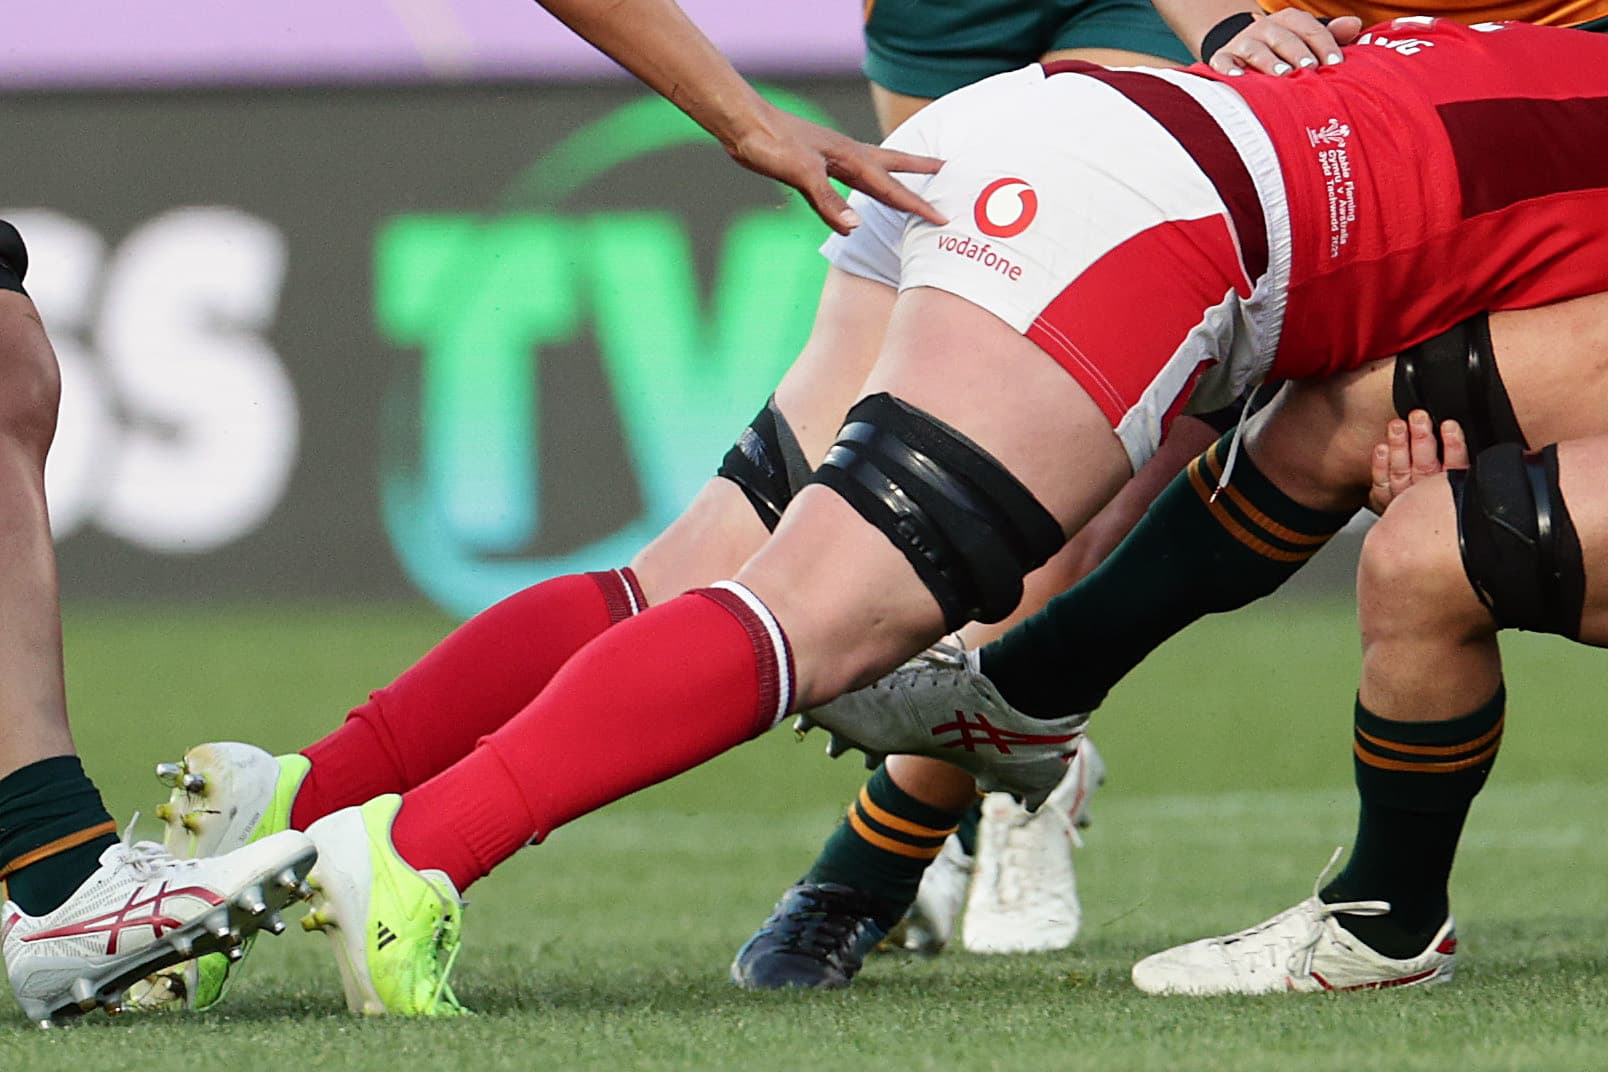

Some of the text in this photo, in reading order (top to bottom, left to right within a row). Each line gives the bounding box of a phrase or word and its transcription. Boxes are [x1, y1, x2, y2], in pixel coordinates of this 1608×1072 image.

[1326, 179, 1339, 232] Tachwedd
[1328, 149, 1342, 183] Cymru
[1339, 199, 1349, 245] Awstralia
[1336, 149, 1356, 222] Abbie Fleming
[937, 234, 1022, 282] vodafone
[376, 209, 835, 554] TV
